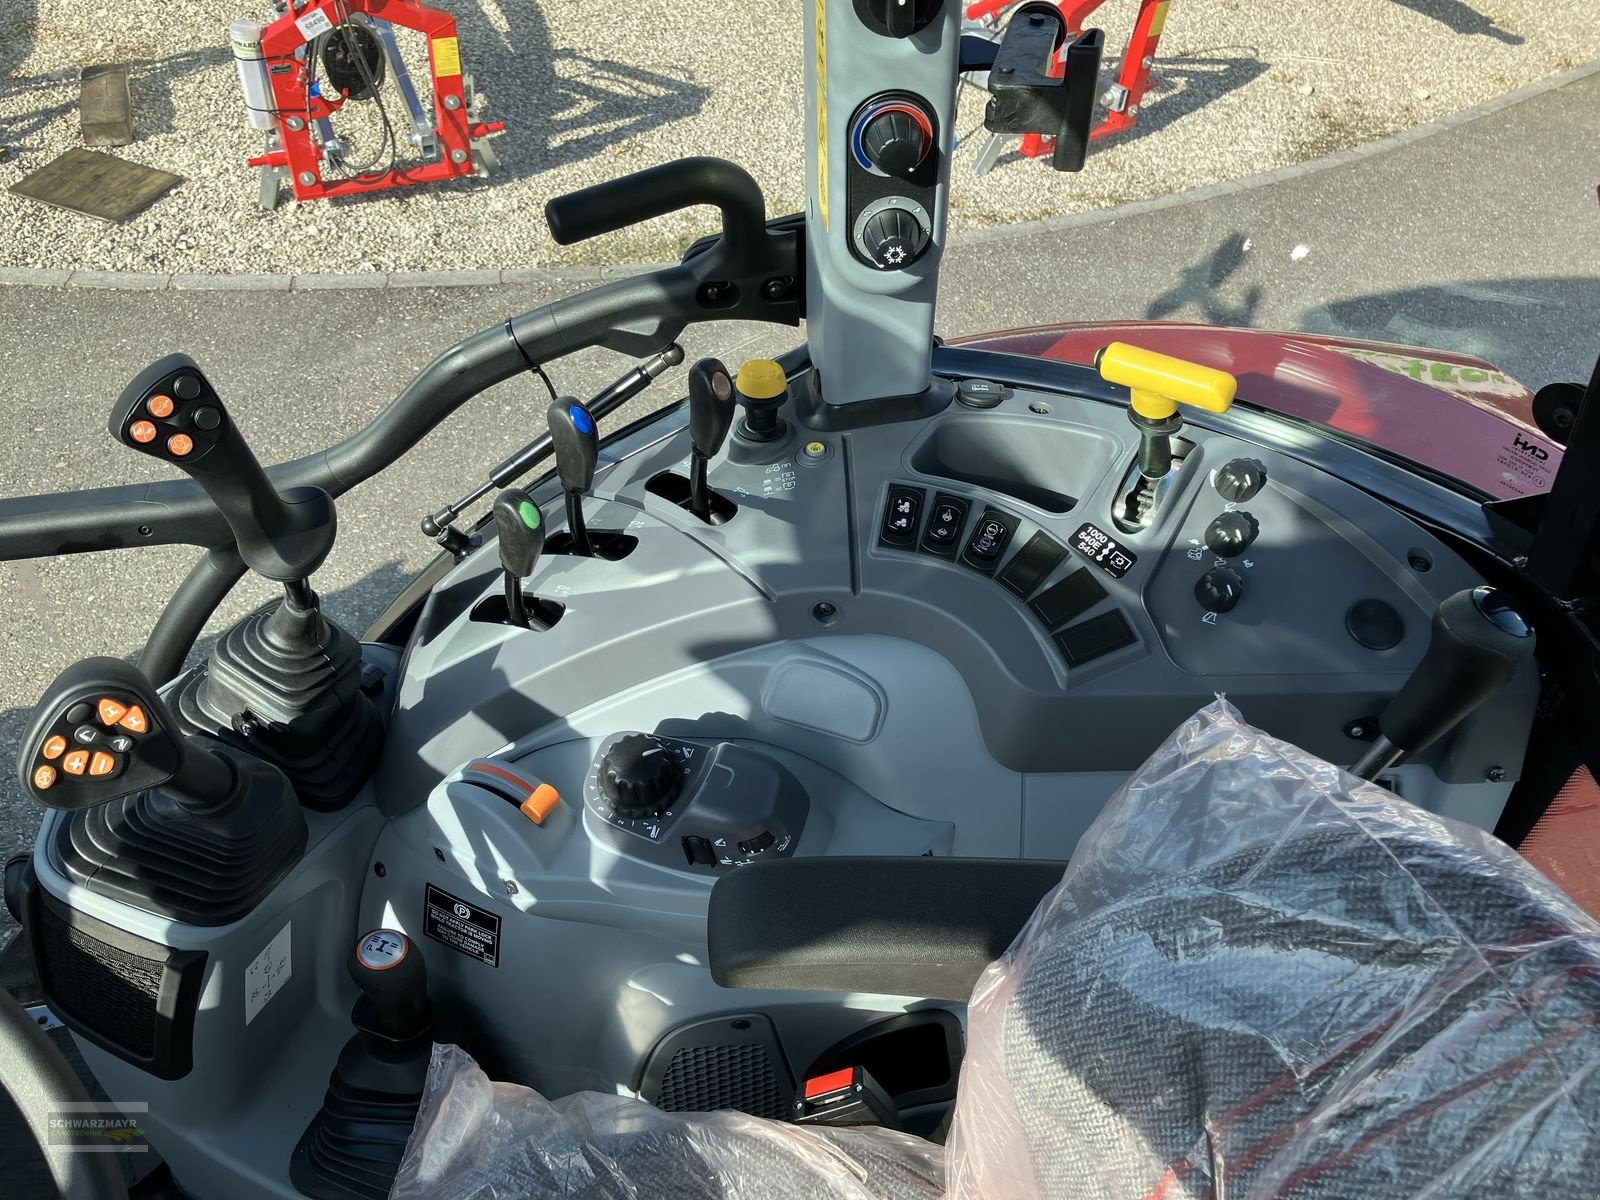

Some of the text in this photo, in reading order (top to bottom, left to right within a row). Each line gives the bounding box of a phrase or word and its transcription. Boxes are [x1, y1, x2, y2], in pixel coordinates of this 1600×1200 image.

[1078, 531, 1102, 550] 540E
[1087, 526, 1108, 543] 1000
[1078, 541, 1095, 556] 540
